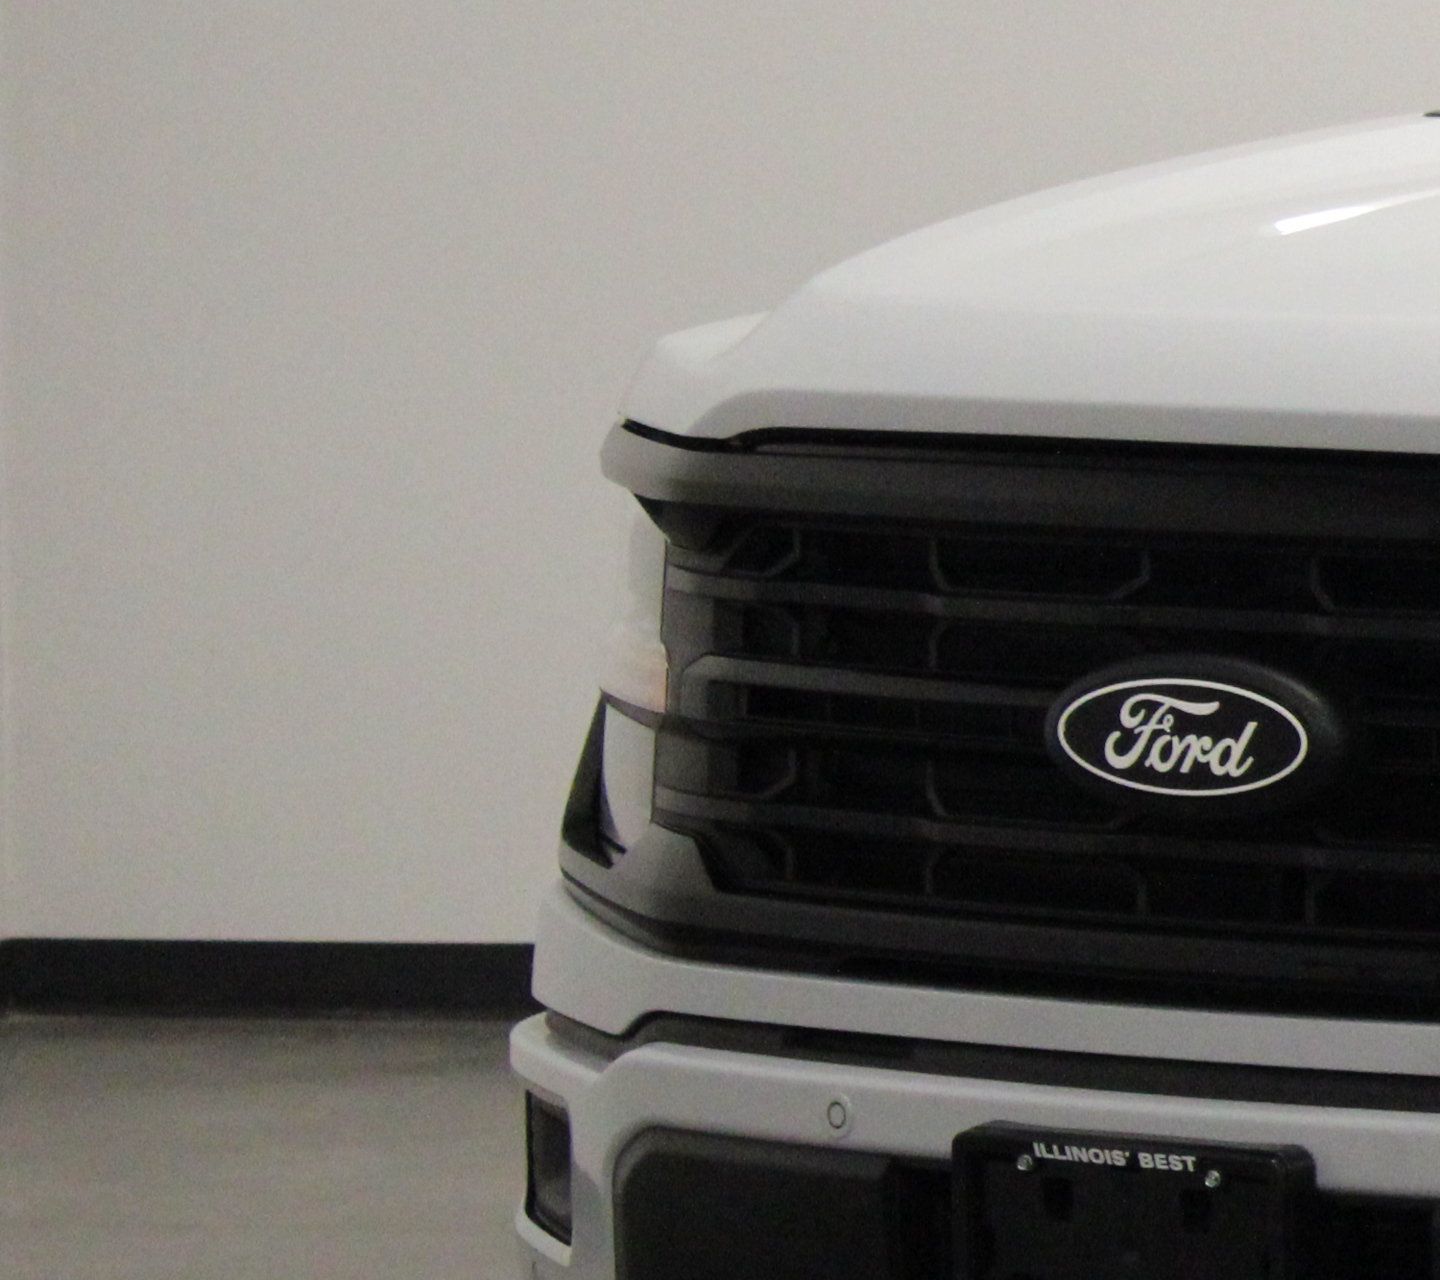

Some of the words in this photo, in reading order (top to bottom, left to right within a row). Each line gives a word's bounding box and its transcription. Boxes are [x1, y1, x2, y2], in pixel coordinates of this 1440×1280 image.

[1104, 692, 1258, 778] Ford
[1032, 1141, 1131, 1167] ILLINOIS'
[1138, 1151, 1197, 1173] BEST
